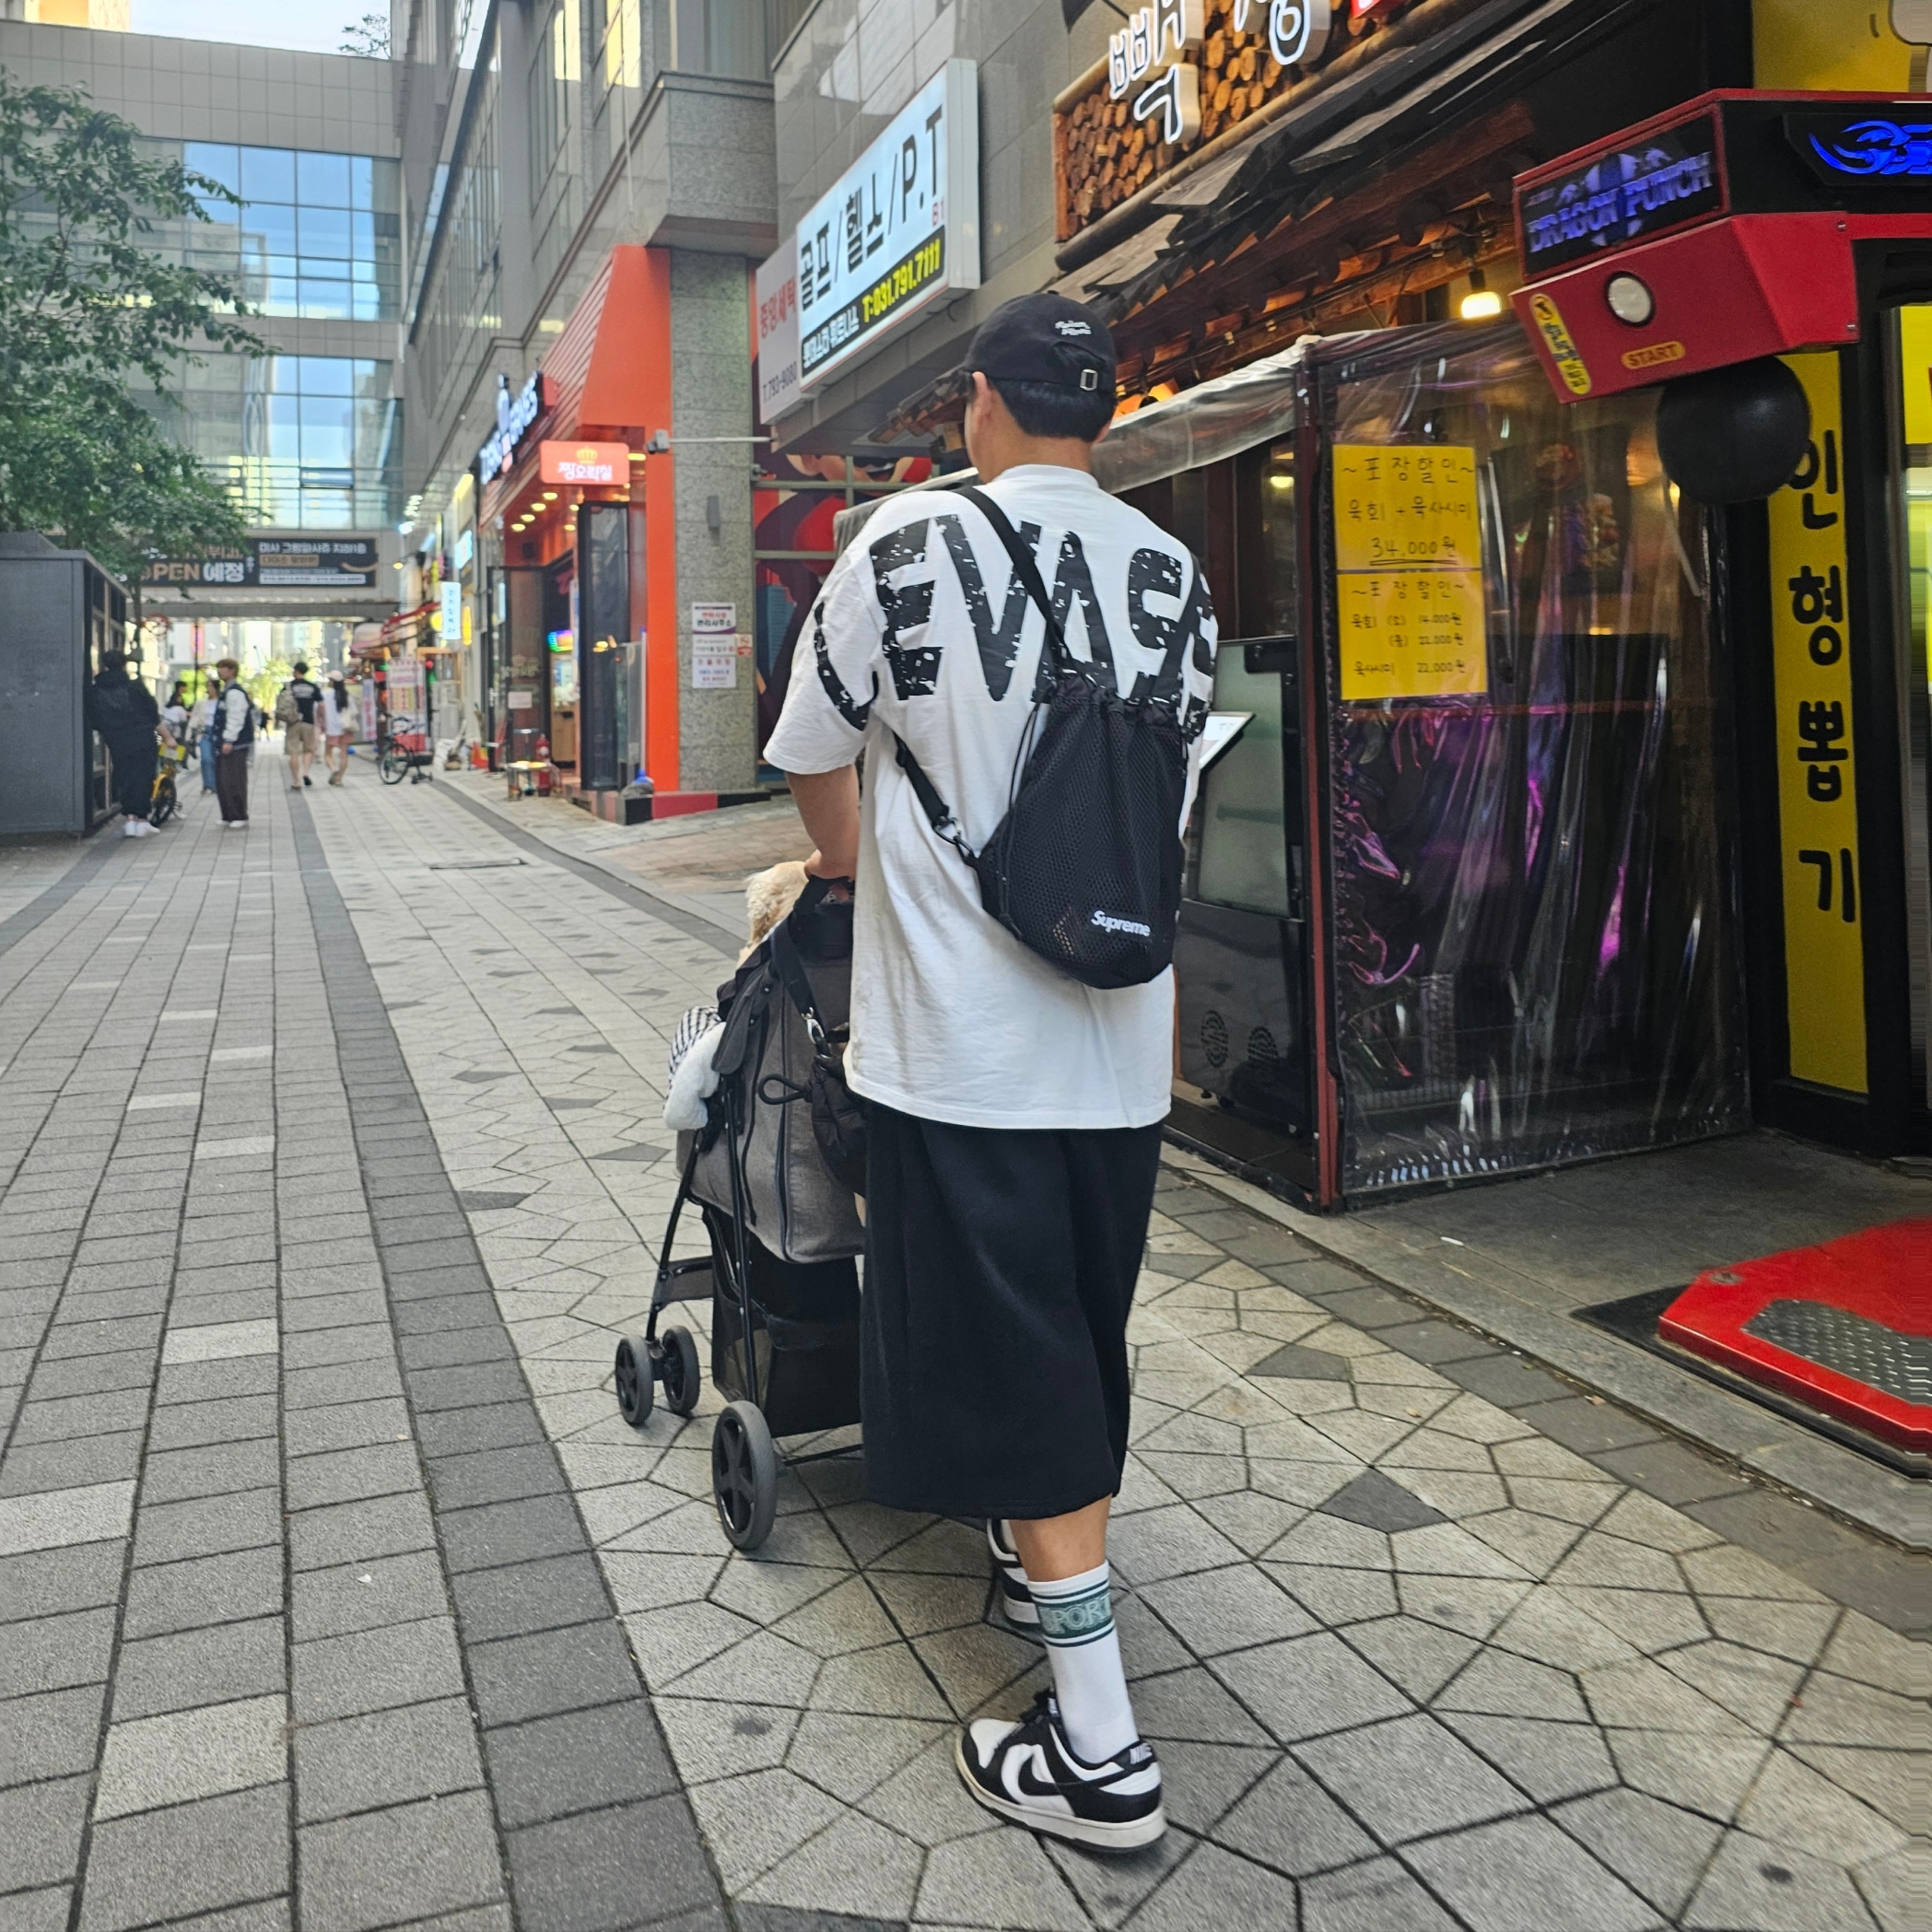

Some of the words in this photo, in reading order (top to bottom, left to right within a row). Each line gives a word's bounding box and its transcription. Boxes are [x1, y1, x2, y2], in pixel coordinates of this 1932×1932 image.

[1622, 151, 1714, 217] PUNCH
[931, 197, 945, 228] B1
[760, 275, 796, 339] 중앙세탁
[1627, 343, 1680, 367] START
[1348, 498, 1386, 522] 육회
[1411, 496, 1471, 521] 육사시미
[203, 562, 244, 582] 예정
[1351, 614, 1377, 628] 육회
[1091, 910, 1151, 937] Supreme
